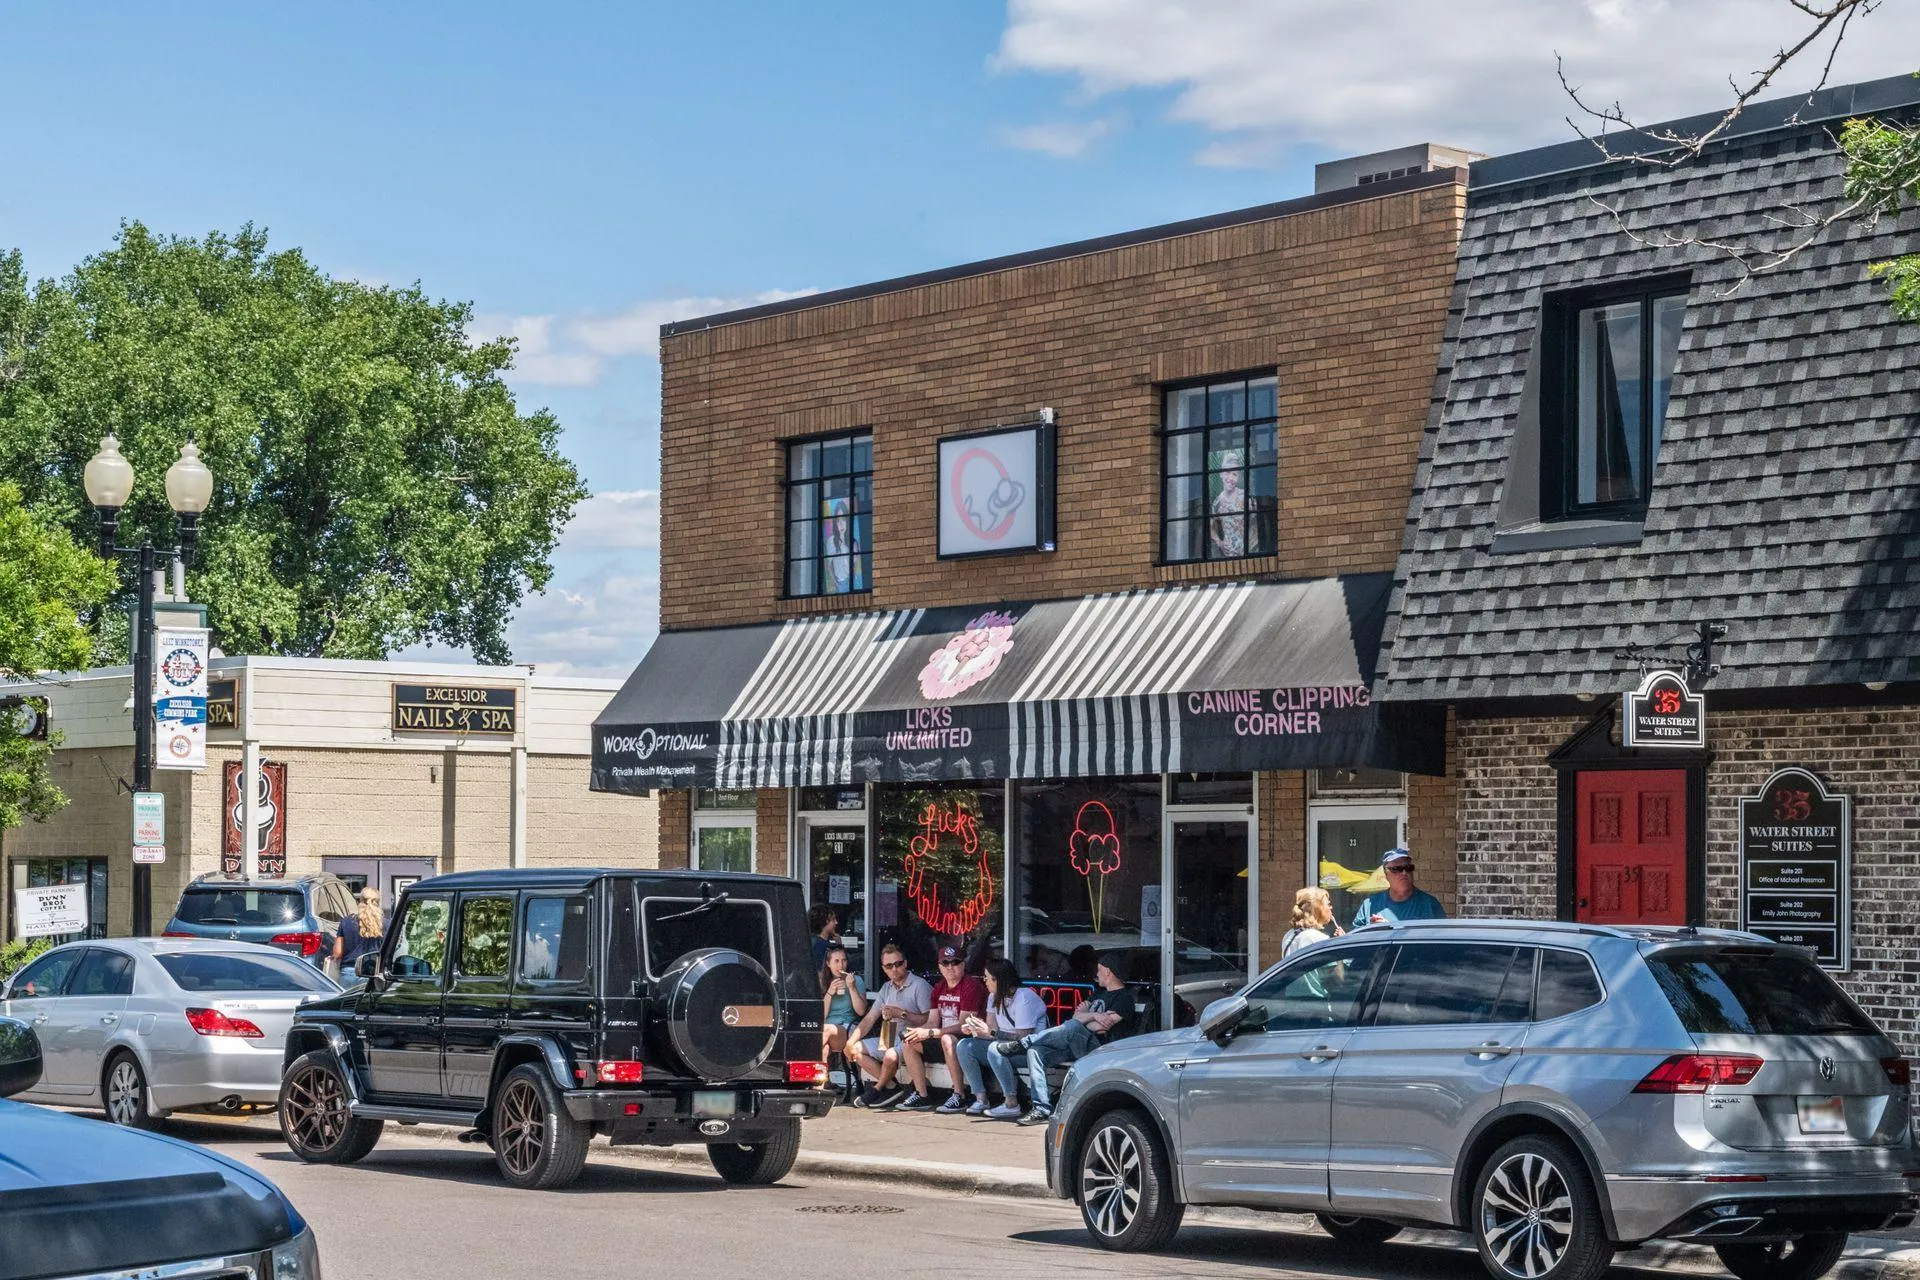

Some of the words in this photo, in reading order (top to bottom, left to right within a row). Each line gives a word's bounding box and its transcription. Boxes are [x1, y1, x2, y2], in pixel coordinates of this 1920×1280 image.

[425, 688, 488, 702] EXCELSIOR
[1187, 690, 1263, 715] CANINE
[1272, 685, 1370, 711] CLIPPING
[1654, 688, 1681, 714] 35
[208, 703, 233, 723] SPA
[398, 708, 454, 728] NAILS
[482, 711, 512, 730] SPA
[906, 706, 953, 730] LICKS
[1639, 716, 1666, 726] WATER
[1667, 717, 1697, 727] STREET
[1234, 711, 1322, 736] CORNER
[1654, 727, 1682, 736] SUITES
[886, 727, 972, 751] UNLIMITED
[612, 766, 633, 777] Private
[634, 766, 655, 776] Wealth
[1749, 826, 1790, 837] WATER
[1791, 826, 1837, 837] STREET
[1771, 841, 1813, 852] SUITES
[225, 858, 285, 872] DNN
